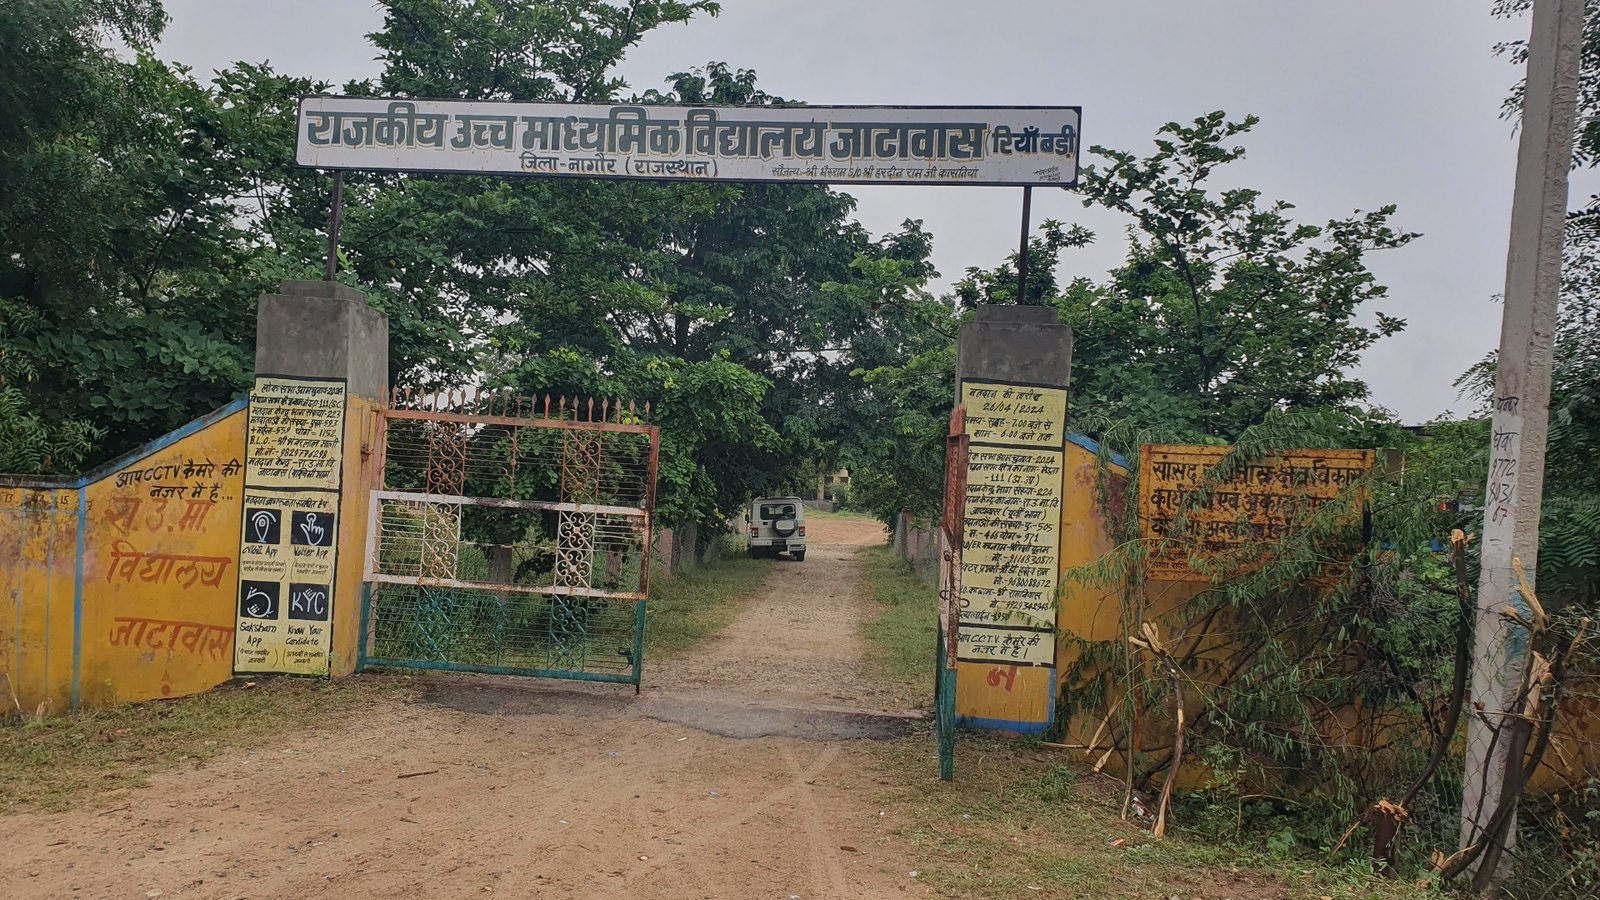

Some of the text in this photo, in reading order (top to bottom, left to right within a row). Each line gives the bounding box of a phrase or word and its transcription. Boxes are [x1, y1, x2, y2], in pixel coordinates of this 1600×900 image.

[305, 101, 449, 150] राजकीय
[450, 114, 518, 152] उच्च
[521, 106, 682, 156] माध्यमिक
[684, 108, 830, 164] विद्यालय
[829, 121, 988, 162] जाटावास
[923, 166, 937, 179] जी
[115, 457, 243, 488] आप CCTV कैमरे की
[149, 485, 189, 500] नजर
[106, 539, 232, 591] विद्यालय
[291, 592, 325, 615] KYC
[109, 616, 235, 662] जाटावास
